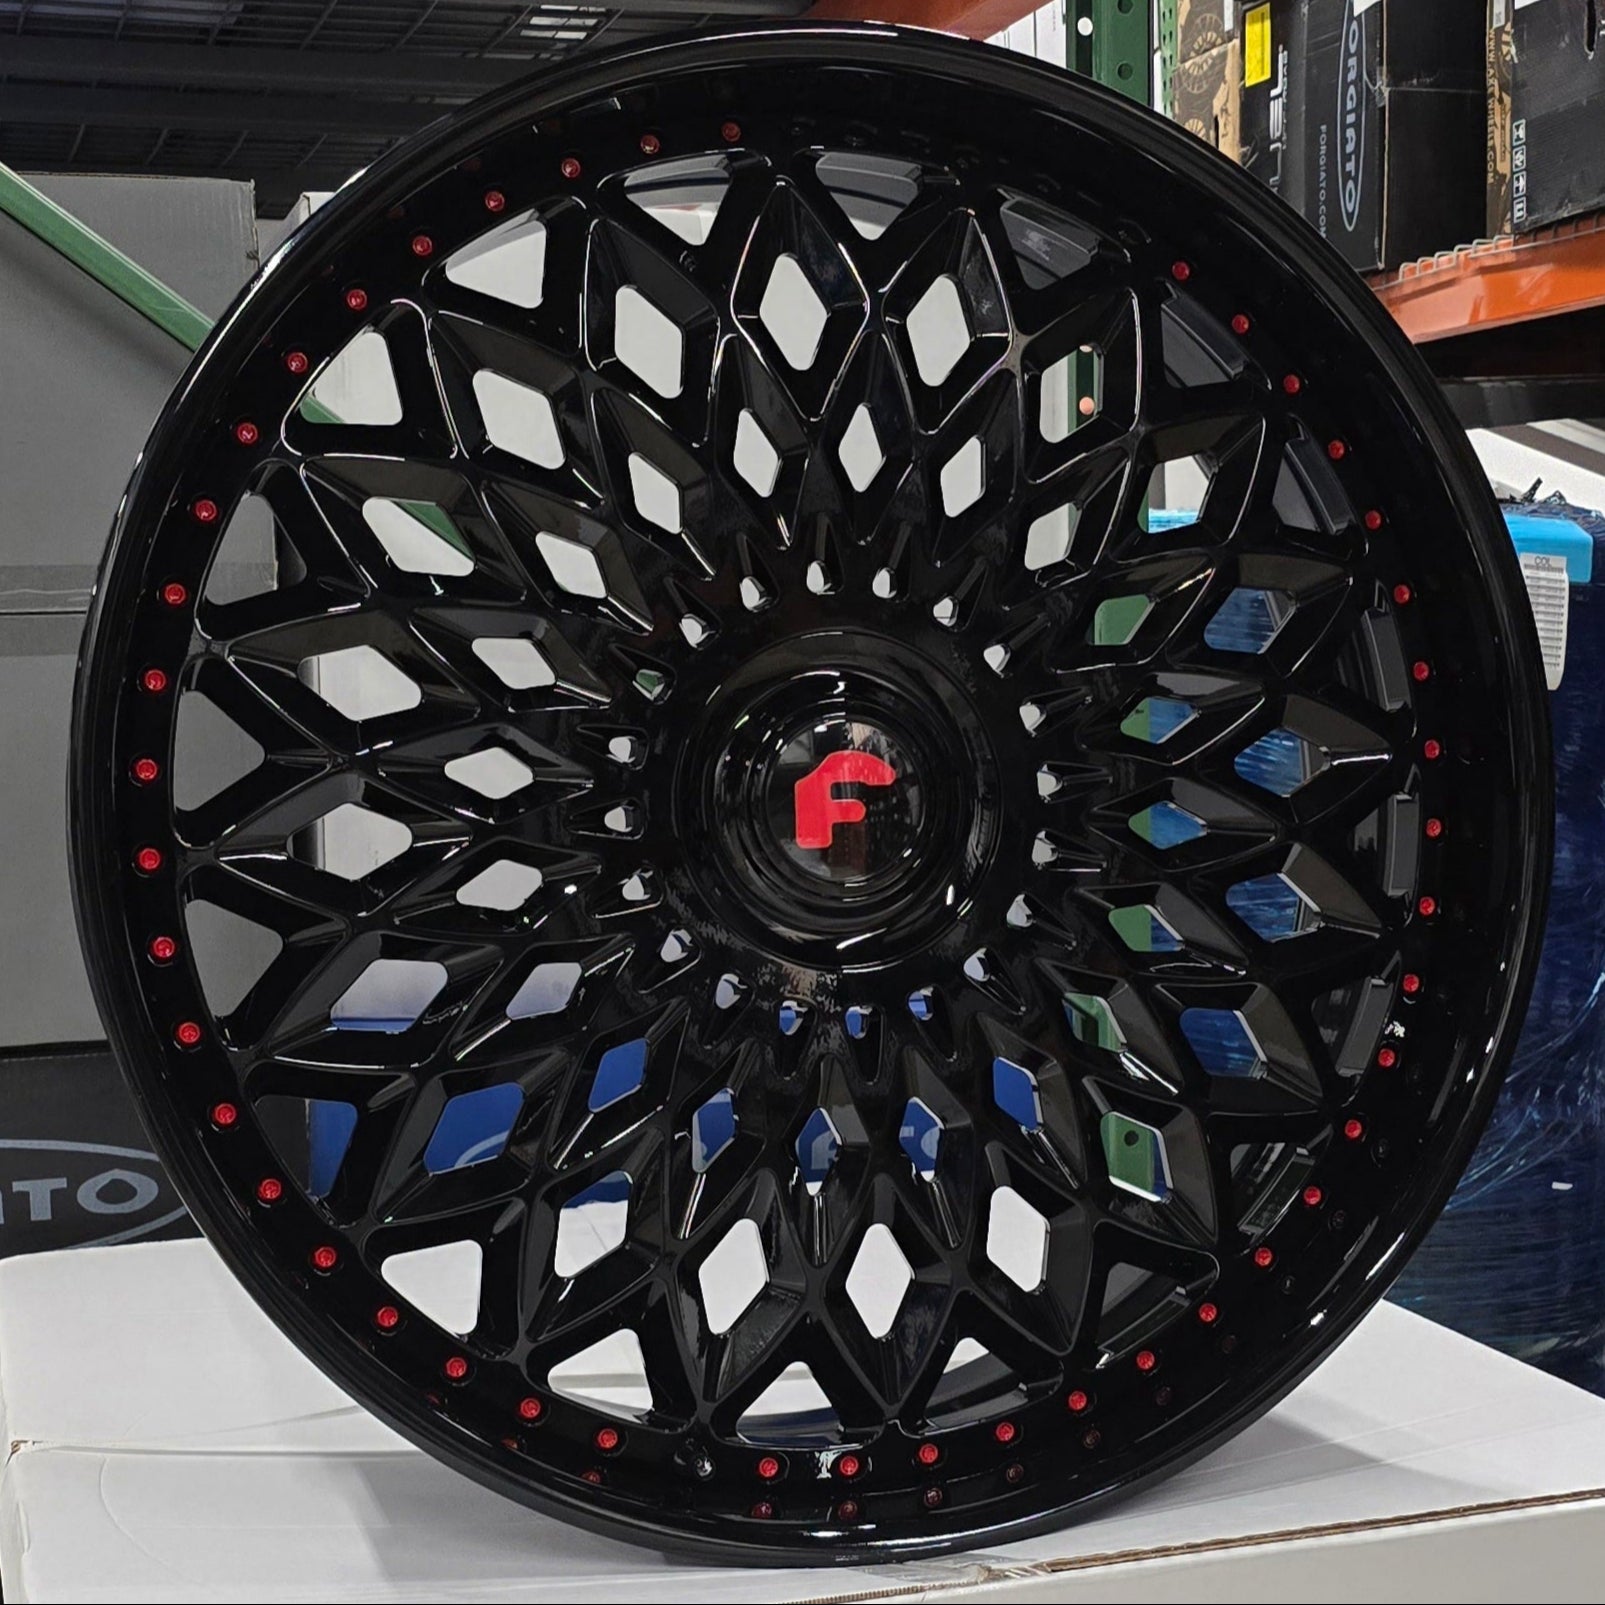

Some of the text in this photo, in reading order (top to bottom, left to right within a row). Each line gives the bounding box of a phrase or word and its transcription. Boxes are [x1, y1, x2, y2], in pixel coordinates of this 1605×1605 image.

[1345, 19, 1360, 214] ORGIATO
[795, 750, 896, 848] F
[0, 1169, 158, 1224] TO
